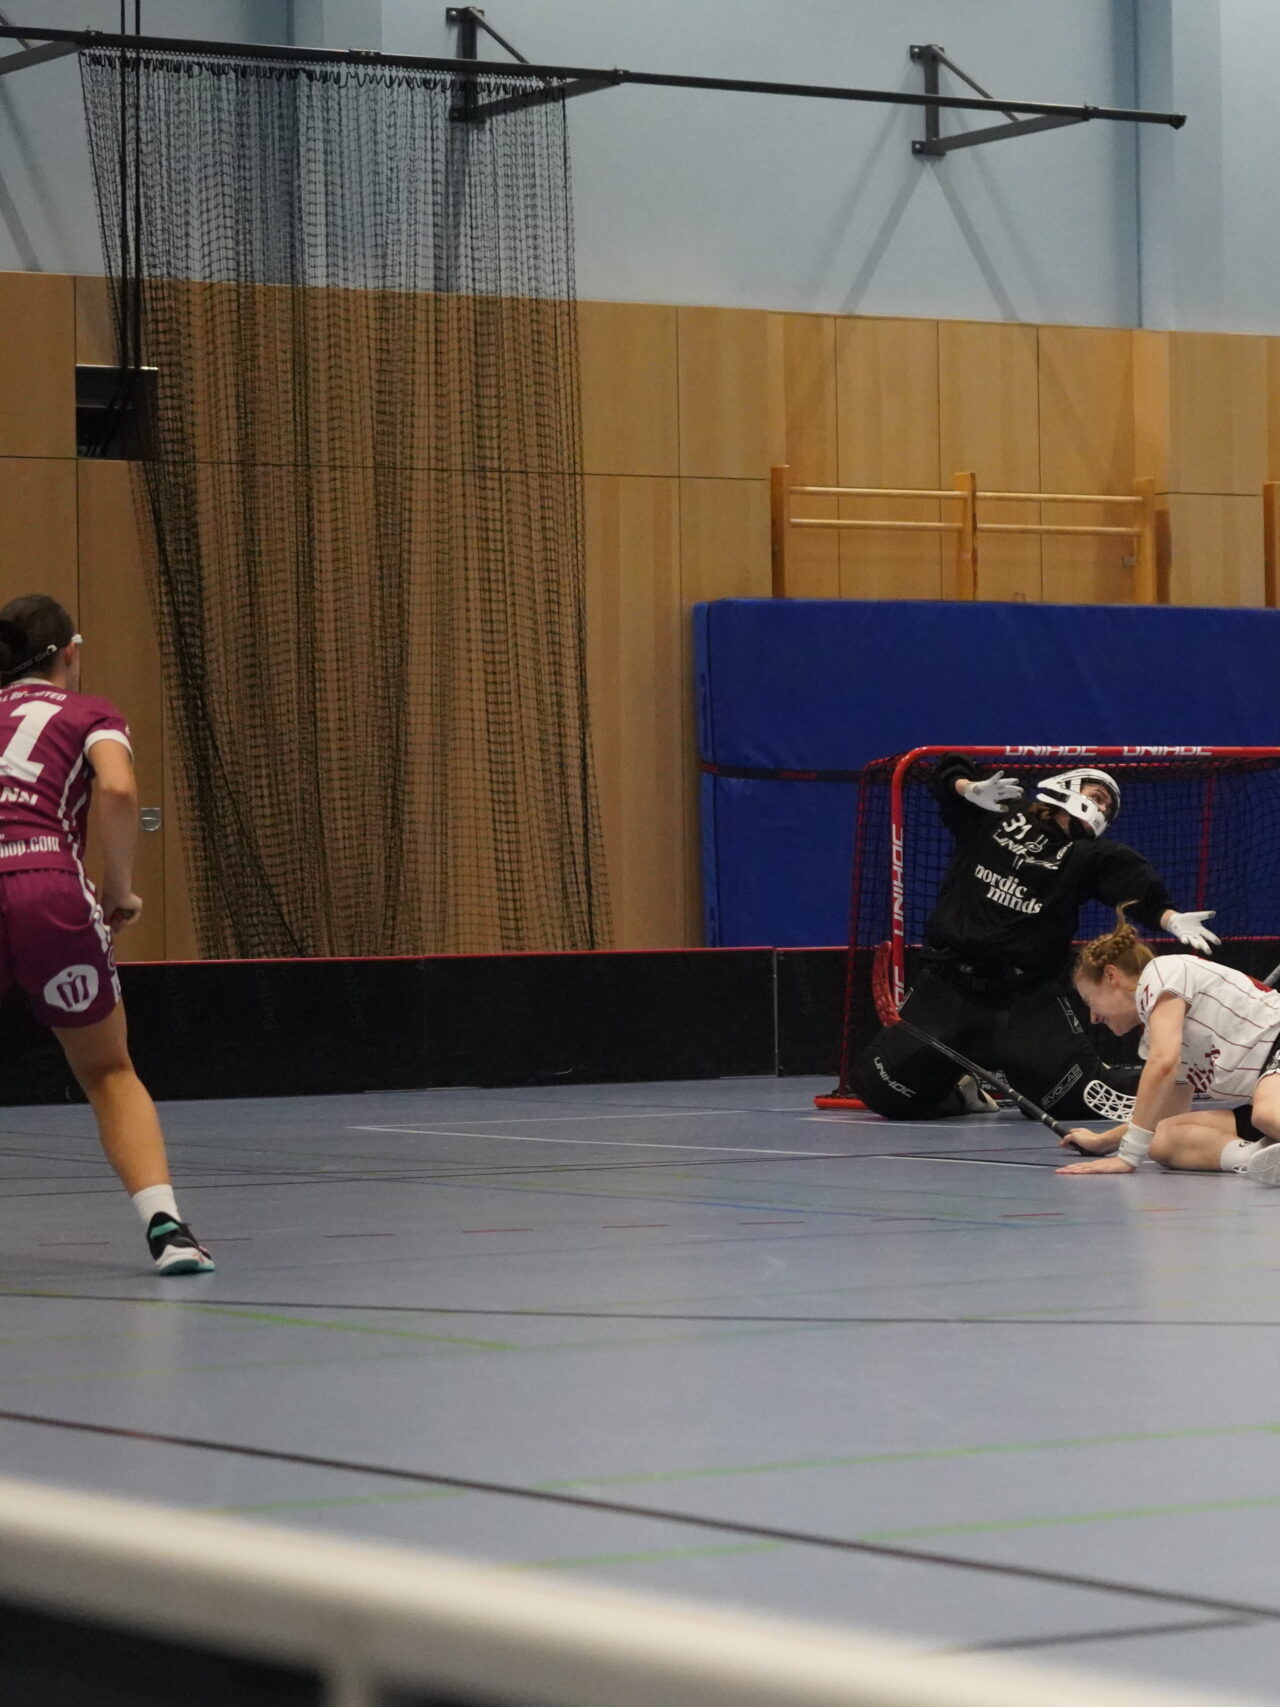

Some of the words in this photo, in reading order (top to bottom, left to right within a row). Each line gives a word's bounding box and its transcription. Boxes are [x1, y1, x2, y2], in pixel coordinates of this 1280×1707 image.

[1005, 745, 1098, 756] UNIHOC
[1122, 746, 1213, 756] UNIHOC
[1001, 812, 1033, 840] 31
[891, 823, 905, 937] UNIHOC
[974, 863, 1028, 898] nordic
[985, 885, 1044, 914] minds
[873, 1056, 917, 1099] UNIHOC
